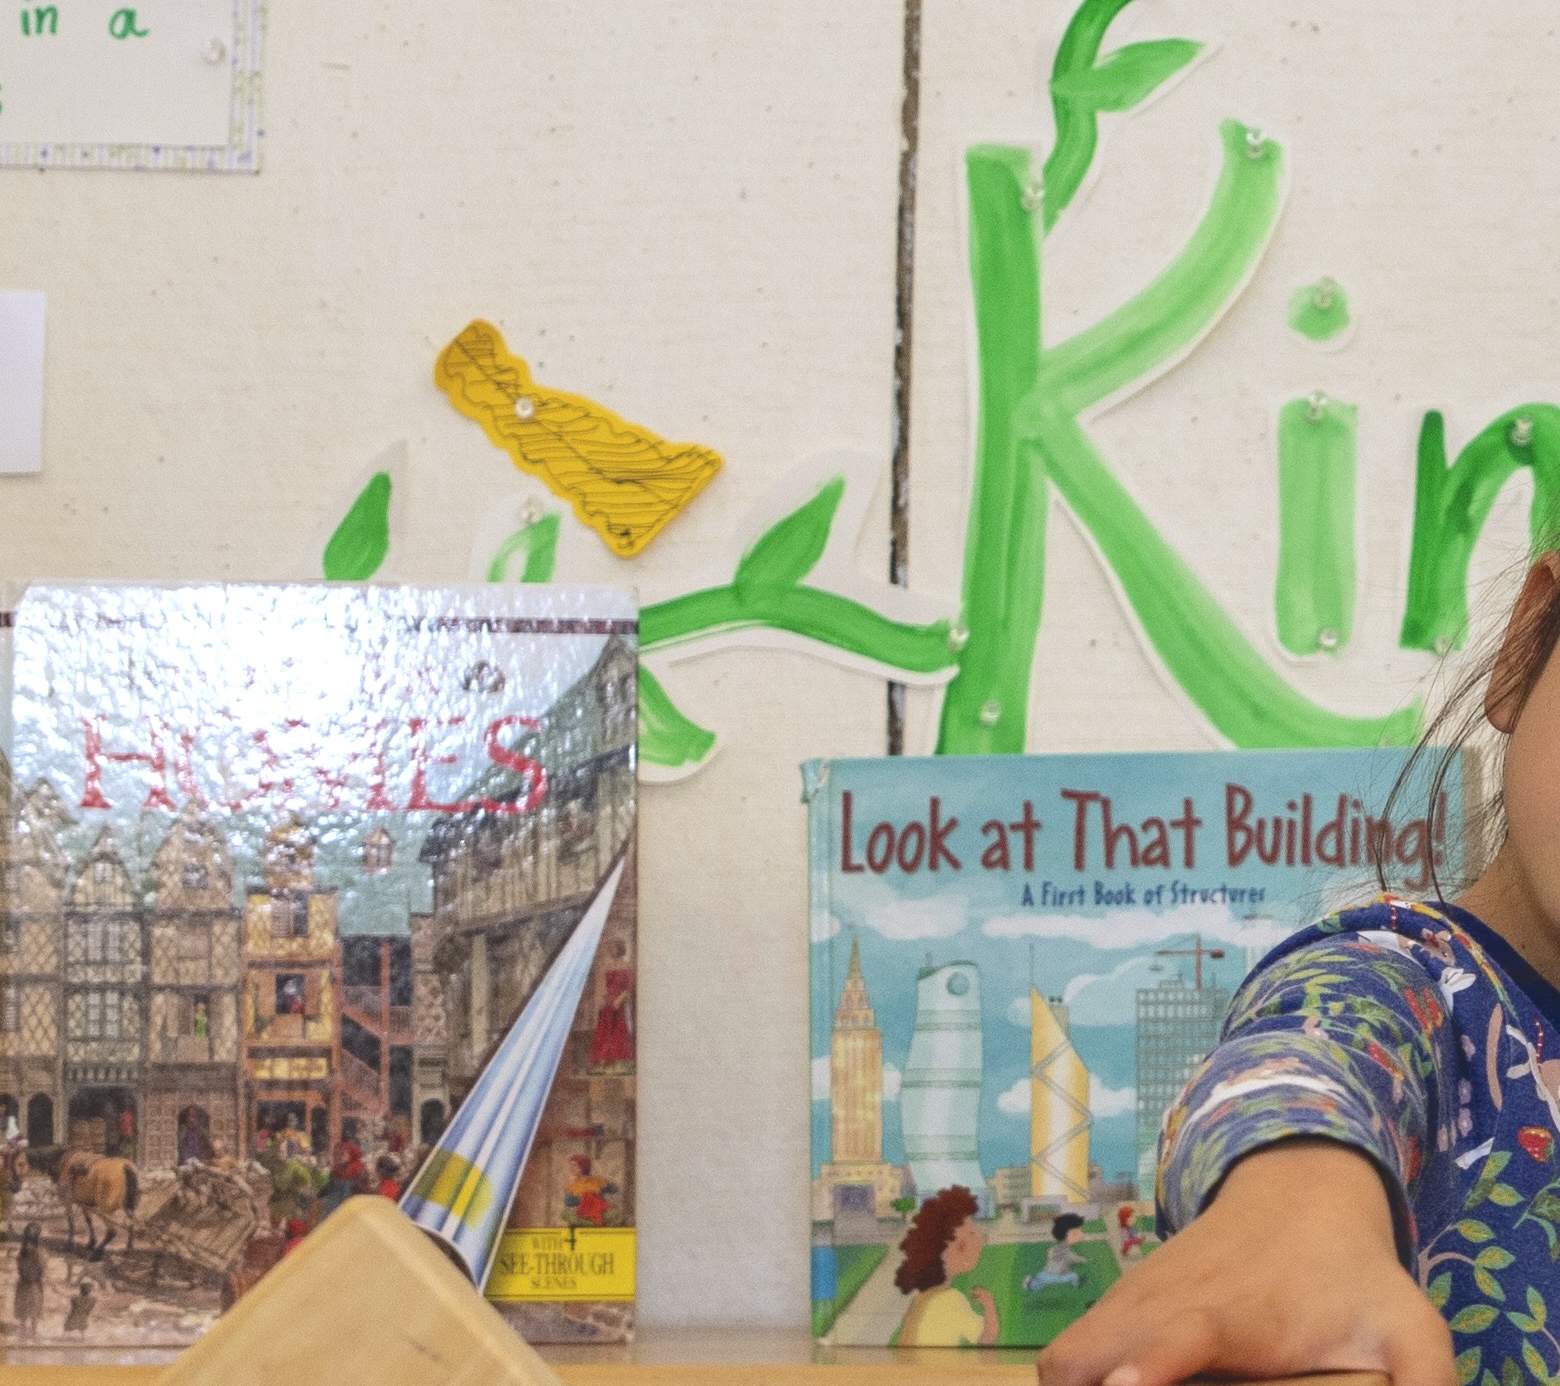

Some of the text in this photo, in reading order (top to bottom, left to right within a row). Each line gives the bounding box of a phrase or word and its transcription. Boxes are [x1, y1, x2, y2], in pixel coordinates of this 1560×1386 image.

[107, 5, 150, 41] a
[840, 783, 1448, 892] Look at That Building!
[1021, 880, 1266, 908] A First Book of Structures
